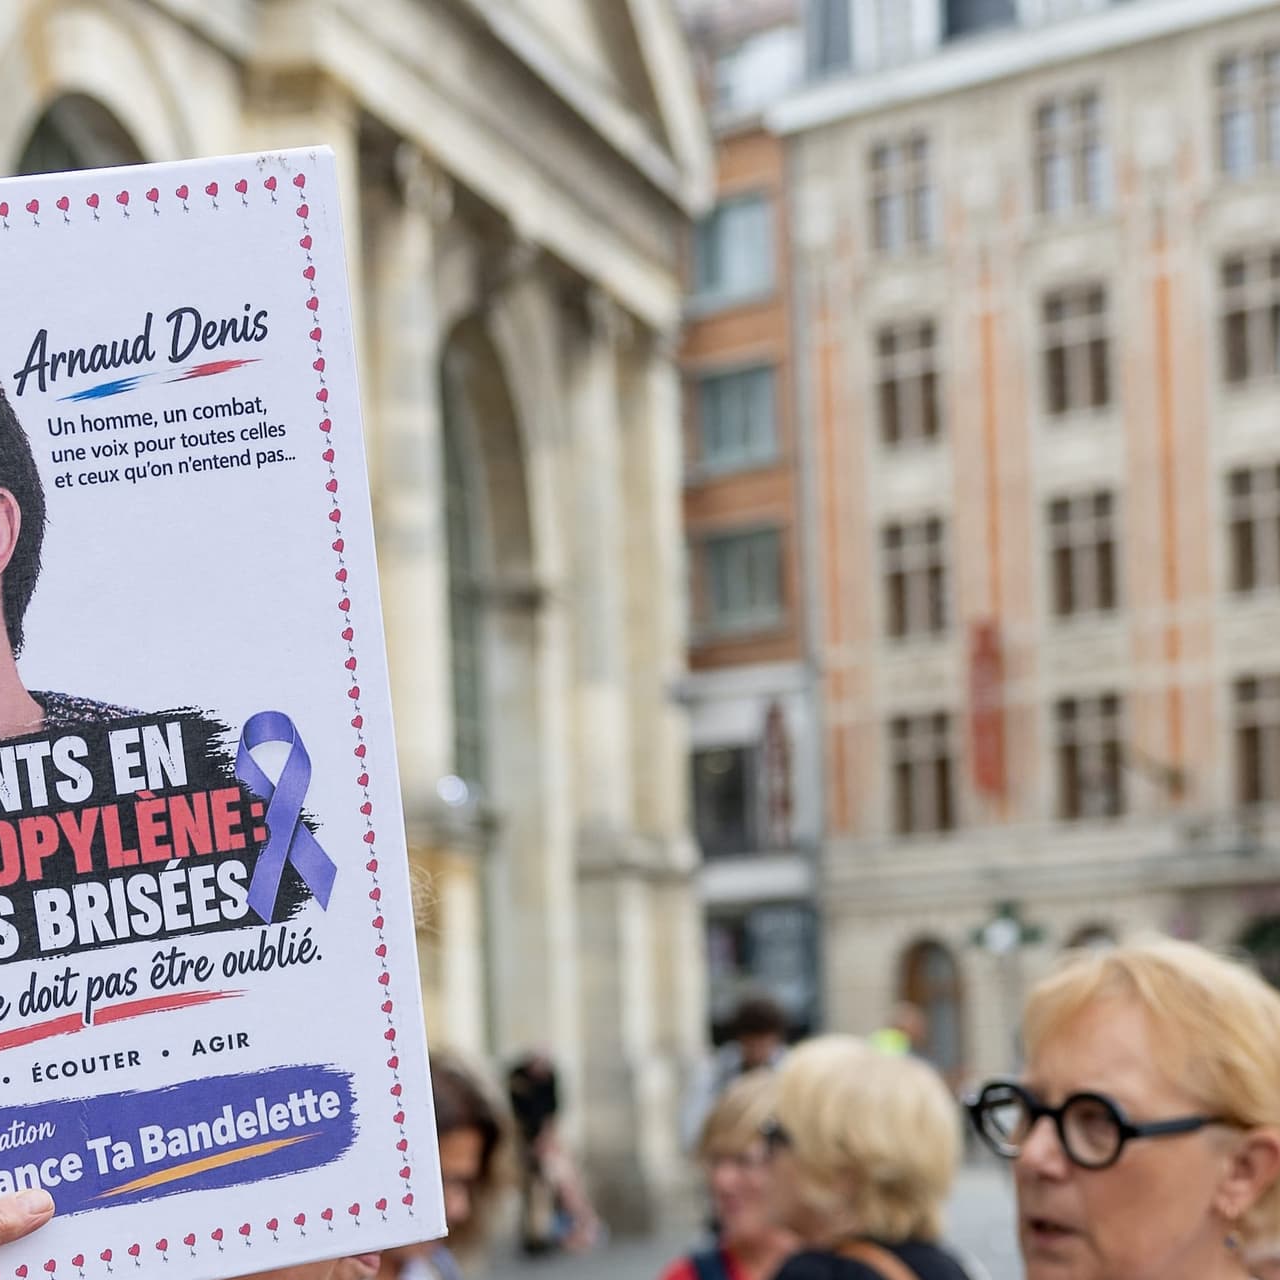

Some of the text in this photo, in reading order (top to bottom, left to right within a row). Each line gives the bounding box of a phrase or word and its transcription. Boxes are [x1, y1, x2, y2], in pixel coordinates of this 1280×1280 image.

[13, 303, 269, 396] Arnaud Denis
[47, 396, 268, 437] Un homme, un combat,
[51, 421, 286, 464] une voix pour toutes celles
[54, 470, 74, 489] et
[78, 469, 120, 487] ceux
[124, 460, 174, 484] qu'on
[178, 449, 252, 476] n'entend
[107, 722, 187, 794] EN
[33, 858, 252, 952] BRISÉES
[18, 968, 79, 1014] doit
[84, 968, 139, 1024] pas
[149, 950, 215, 990] être
[221, 927, 323, 979] oublié.
[31, 1048, 142, 1084] ÉCOUTER
[190, 1032, 250, 1057] AGIR
[86, 1136, 135, 1176] Ta
[139, 1088, 341, 1162] Bandelette
